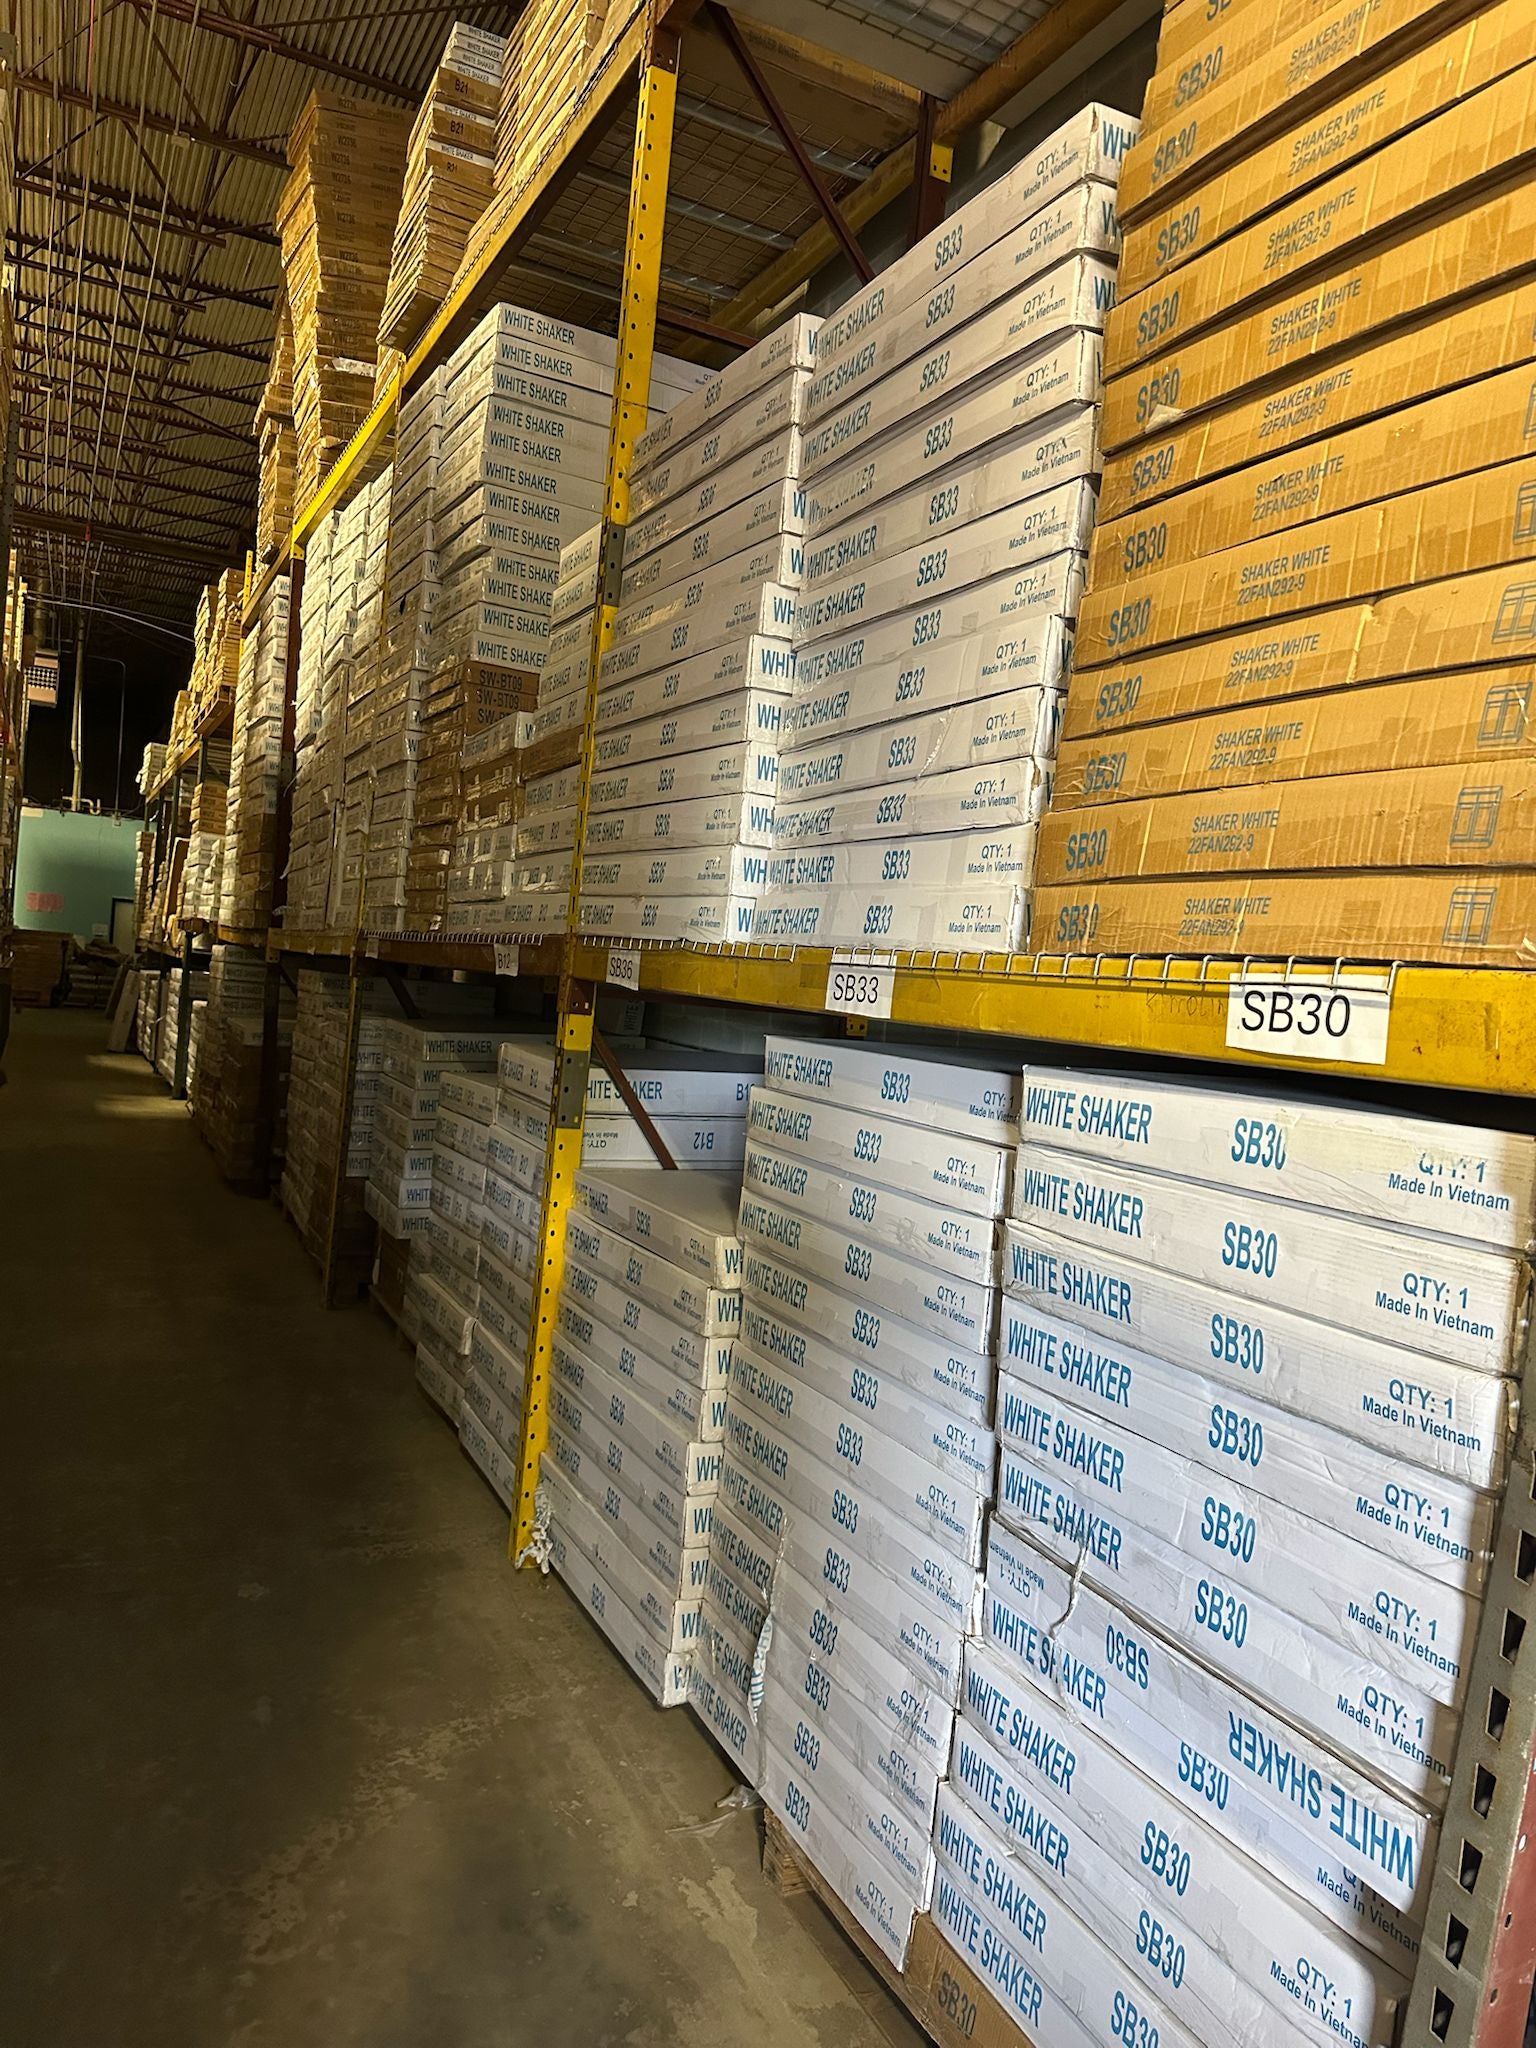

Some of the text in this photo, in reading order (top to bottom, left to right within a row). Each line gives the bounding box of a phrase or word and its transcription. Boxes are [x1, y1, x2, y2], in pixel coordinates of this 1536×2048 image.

[463, 54, 494, 70] WHITE SHAKER
[1175, 46, 1223, 108] SB30
[455, 79, 468, 94] B21
[451, 121, 464, 134] B21
[1293, 89, 1387, 157] SHAKER WHITE
[1029, 209, 1061, 243] QTY: 1
[1156, 206, 1200, 266] SB30
[1268, 187, 1357, 250] SHAKER WHITE
[935, 224, 963, 272] SB33
[1015, 220, 1072, 265] Made In Vietnam
[504, 309, 575, 345] WHITE SHAKER
[925, 285, 955, 328] SB33
[1137, 291, 1179, 347] SB30
[501, 343, 572, 376] WHITE SHAKER
[807, 342, 876, 408] WHITE SHAKER
[497, 373, 567, 407] WHITE SHAKER
[1264, 369, 1353, 418] SHAKER WHITE
[805, 402, 871, 464] WHITE SHAKER
[486, 462, 557, 493] WHITE SHAKER
[1130, 445, 1174, 496] SB30
[1256, 455, 1344, 500] SHAKER WHITE
[1124, 523, 1167, 573] SB30
[1241, 545, 1331, 584] SHAKER WHITE
[1000, 588, 1055, 614] Made In Vietnam
[1015, 574, 1046, 596] QTY: 1
[1237, 574, 1306, 606] 22FAN292-9
[913, 610, 941, 646] SB33
[1107, 599, 1151, 647] SB30
[799, 640, 864, 684] WHITE SHAKER
[1231, 634, 1320, 667] SHAKER WHITE
[480, 670, 522, 691] SW-BT09
[663, 674, 680, 698] SB36
[1225, 660, 1294, 688] 22FAN292-9
[1096, 676, 1141, 720] SB30
[1215, 722, 1303, 750] SHAKER WHITE
[654, 814, 671, 837] SB36
[1192, 810, 1280, 833] SHAKER WHITE
[770, 856, 835, 884] WHITE SHAKER
[882, 850, 911, 880] SB33
[968, 862, 1023, 873] Made In Vietnam
[981, 846, 1011, 859] QTY: 1
[1065, 829, 1107, 871] SB30
[757, 908, 820, 934] WHITE SHAKER
[864, 905, 893, 934] SB33
[948, 922, 1001, 933] Made In Vietnam
[962, 905, 992, 919] QTY: 1
[498, 953, 510, 969] B12
[609, 957, 633, 979] SB36
[833, 974, 878, 1004] SB33
[1242, 991, 1350, 1037] SB30
[427, 1040, 492, 1053] WHITE SHAKER
[768, 1051, 833, 1087] WHITE SHAKER
[881, 1070, 910, 1103] SB33
[751, 1102, 811, 1142] WHITE SHAKER
[1026, 1087, 1152, 1145] WHITE SHAKER
[694, 1132, 713, 1149] B12
[855, 1129, 882, 1163] SB33
[1232, 1118, 1286, 1171] SB30
[933, 1170, 985, 1195] Made In Vietnam
[947, 1157, 976, 1177] QTY: 1
[1477, 1161, 1486, 1183] 1
[1024, 1169, 1143, 1239] WHITE SHAKER
[1389, 1173, 1510, 1213] Made In Vietnam
[742, 1205, 801, 1250] WHITE SHAKER
[845, 1245, 872, 1281] SB33
[1222, 1221, 1278, 1279] SB30
[1012, 1244, 1132, 1325] WHITE SHAKER
[1403, 1272, 1469, 1309] QTY: 1
[853, 1309, 880, 1349] SB33
[1376, 1291, 1494, 1341] Made In Vietnam
[1008, 1319, 1132, 1408] WHITE SHAKER
[1210, 1313, 1264, 1375] SB30
[837, 1424, 863, 1466] SB33
[1004, 1392, 1125, 1493] WHITE SHAKER
[1209, 1404, 1263, 1467] SB30
[1385, 1483, 1450, 1528] QTY: 1
[1202, 1496, 1256, 1563] SB30
[1356, 1496, 1474, 1563] Made In Vietnam
[1194, 1579, 1248, 1649] SB30
[1106, 1625, 1149, 1689] SB30
[968, 1669, 1076, 1794] WHITE SHAKER
[785, 1781, 811, 1832] SB33
[960, 1741, 1069, 1876] WHITE SHAKER
[1228, 1711, 1414, 1889] WHITE SHAKER
[1141, 1820, 1191, 1897] SB30
[940, 1811, 1047, 1953] WHITE SHAKER
[1136, 1909, 1186, 1988] SB30
[938, 1971, 976, 2039] SB30
